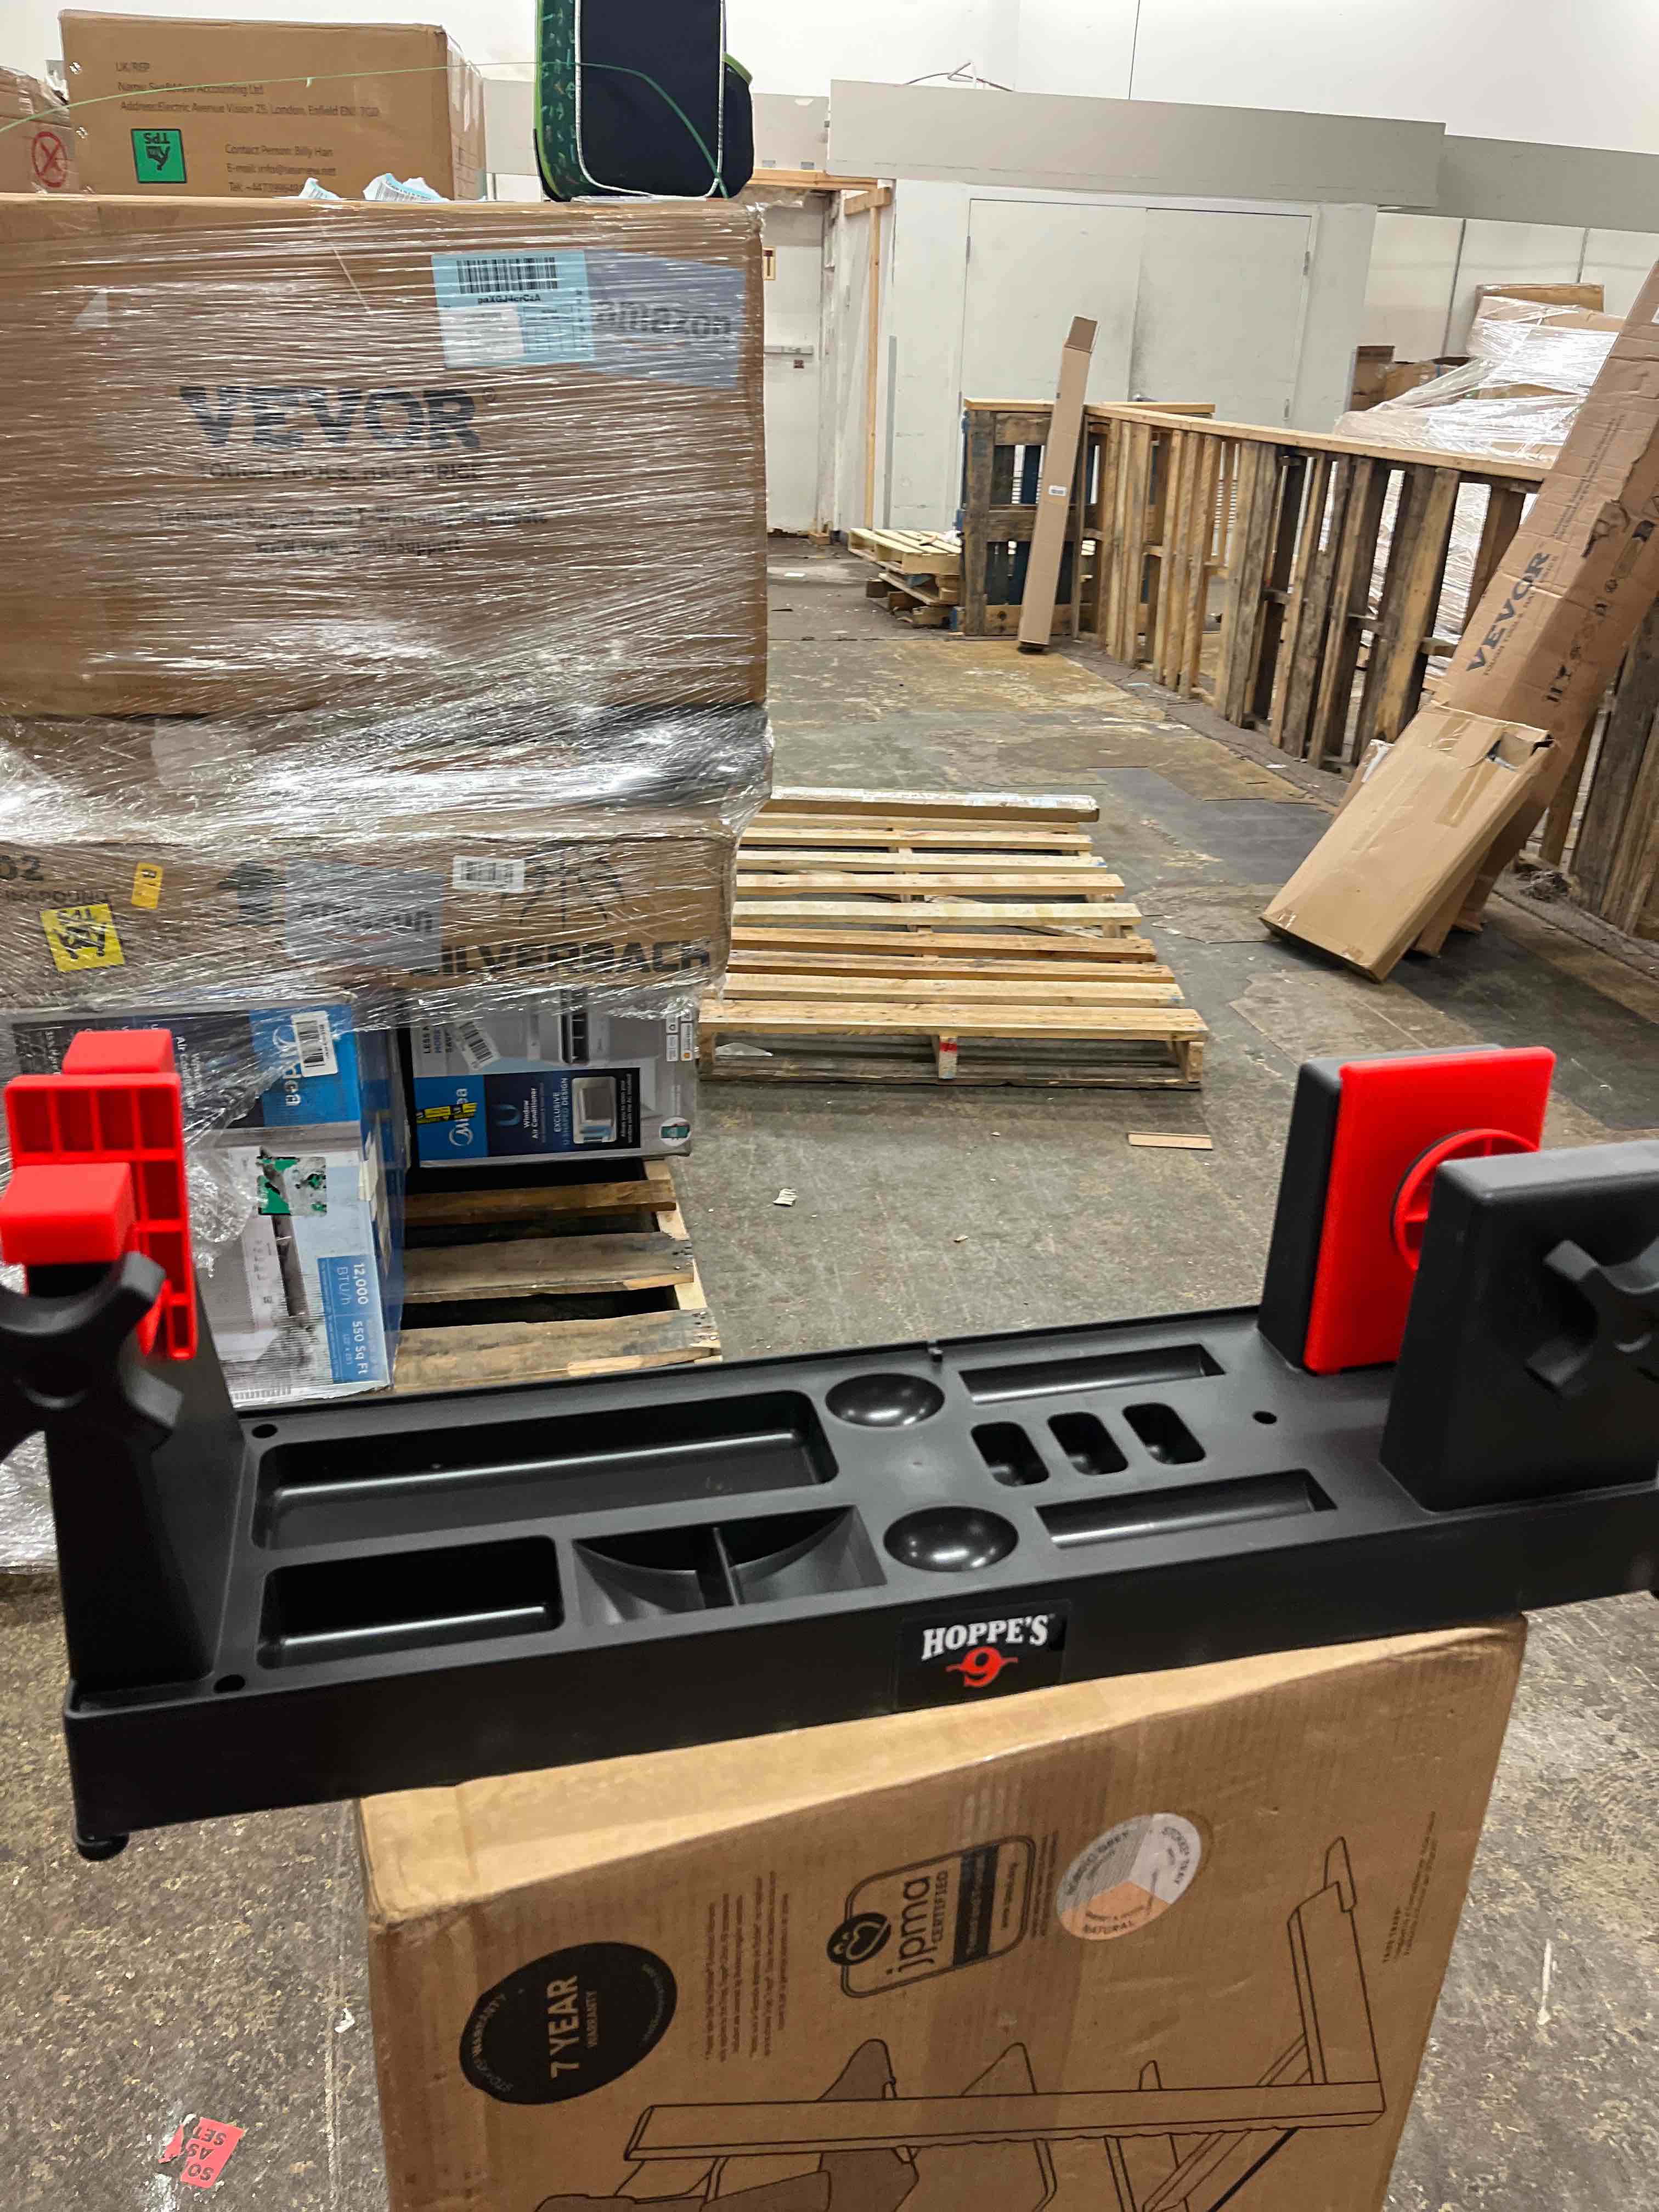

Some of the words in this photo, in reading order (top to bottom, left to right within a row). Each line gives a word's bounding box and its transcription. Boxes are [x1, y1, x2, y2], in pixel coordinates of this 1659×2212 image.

[143, 132, 170, 144] TPS
[179, 385, 482, 450] VEVOR
[1465, 551, 1551, 672] VEVOR
[523, 1099, 532, 1128] Window
[531, 1087, 539, 1127] Conditioner
[553, 1092, 562, 1132] EXCLUSIVE
[531, 1128, 540, 1139] Air
[336, 1266, 351, 1305] BTU/h
[353, 1263, 369, 1305] 12,000
[352, 1320, 365, 1342] 550
[354, 1345, 366, 1361] Sq
[357, 1362, 369, 1375] Ft
[921, 1613, 1049, 1662] HOPPE'S
[885, 1875, 938, 1976] jpma
[931, 1869, 949, 1944] CERTIFIED
[546, 1975, 580, 2056] YEAR
[550, 2061, 580, 2080] 7
[193, 2126, 227, 2146] SET
